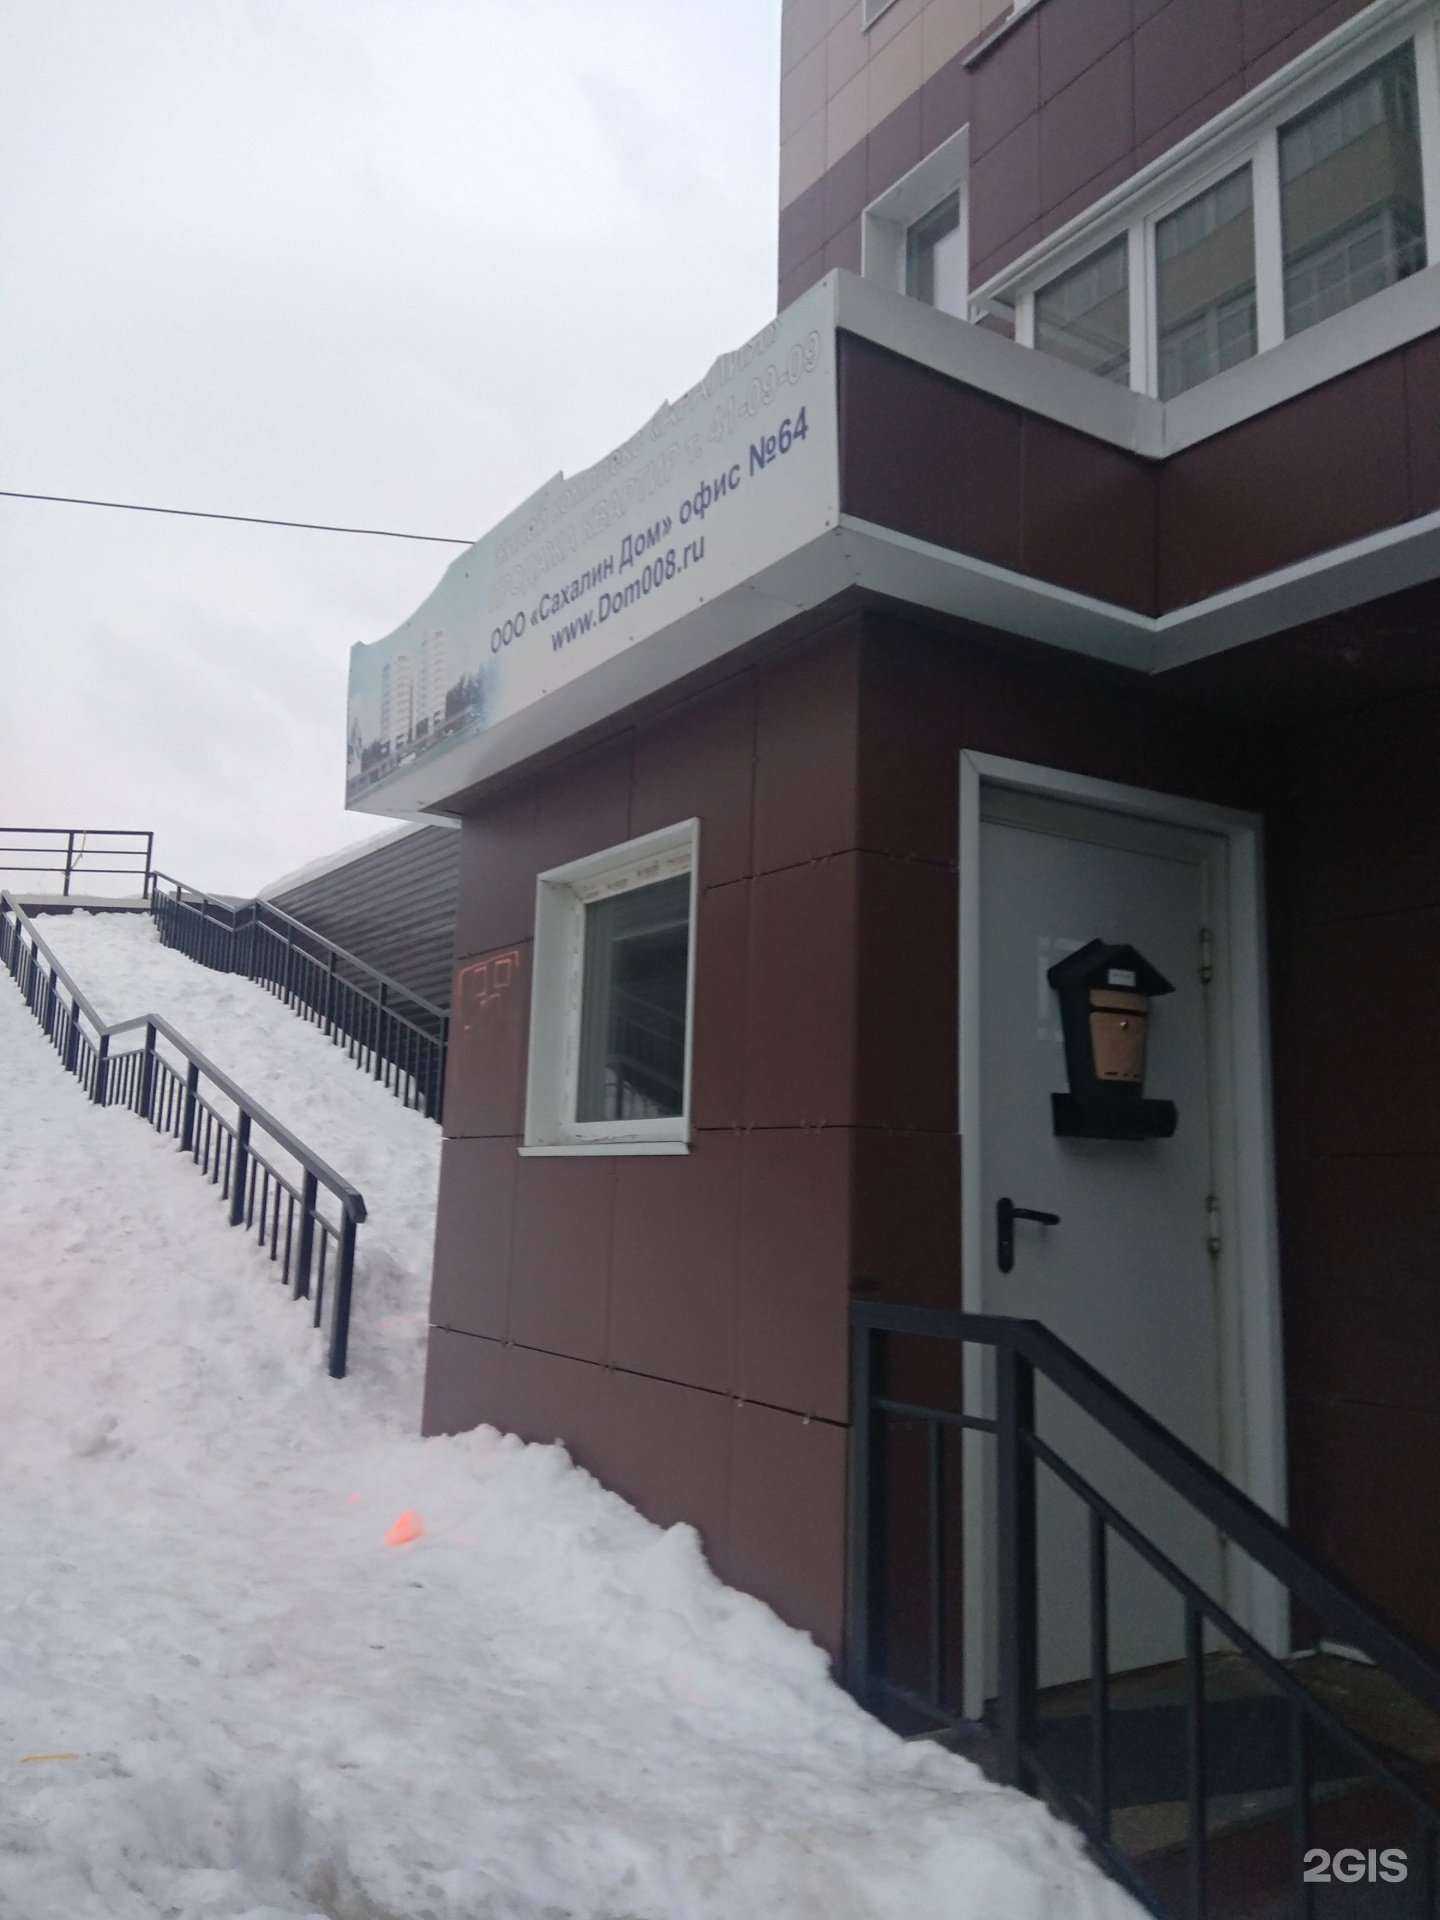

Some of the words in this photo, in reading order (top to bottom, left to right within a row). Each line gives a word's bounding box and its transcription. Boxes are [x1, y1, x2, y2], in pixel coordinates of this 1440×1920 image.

[490, 611, 526, 654] ООО
[529, 553, 615, 627] «Сахалин
[618, 515, 674, 575] Дом»
[679, 463, 742, 520] офис
[748, 405, 809, 477] №64
[550, 535, 706, 652] www.Dom008.ru
